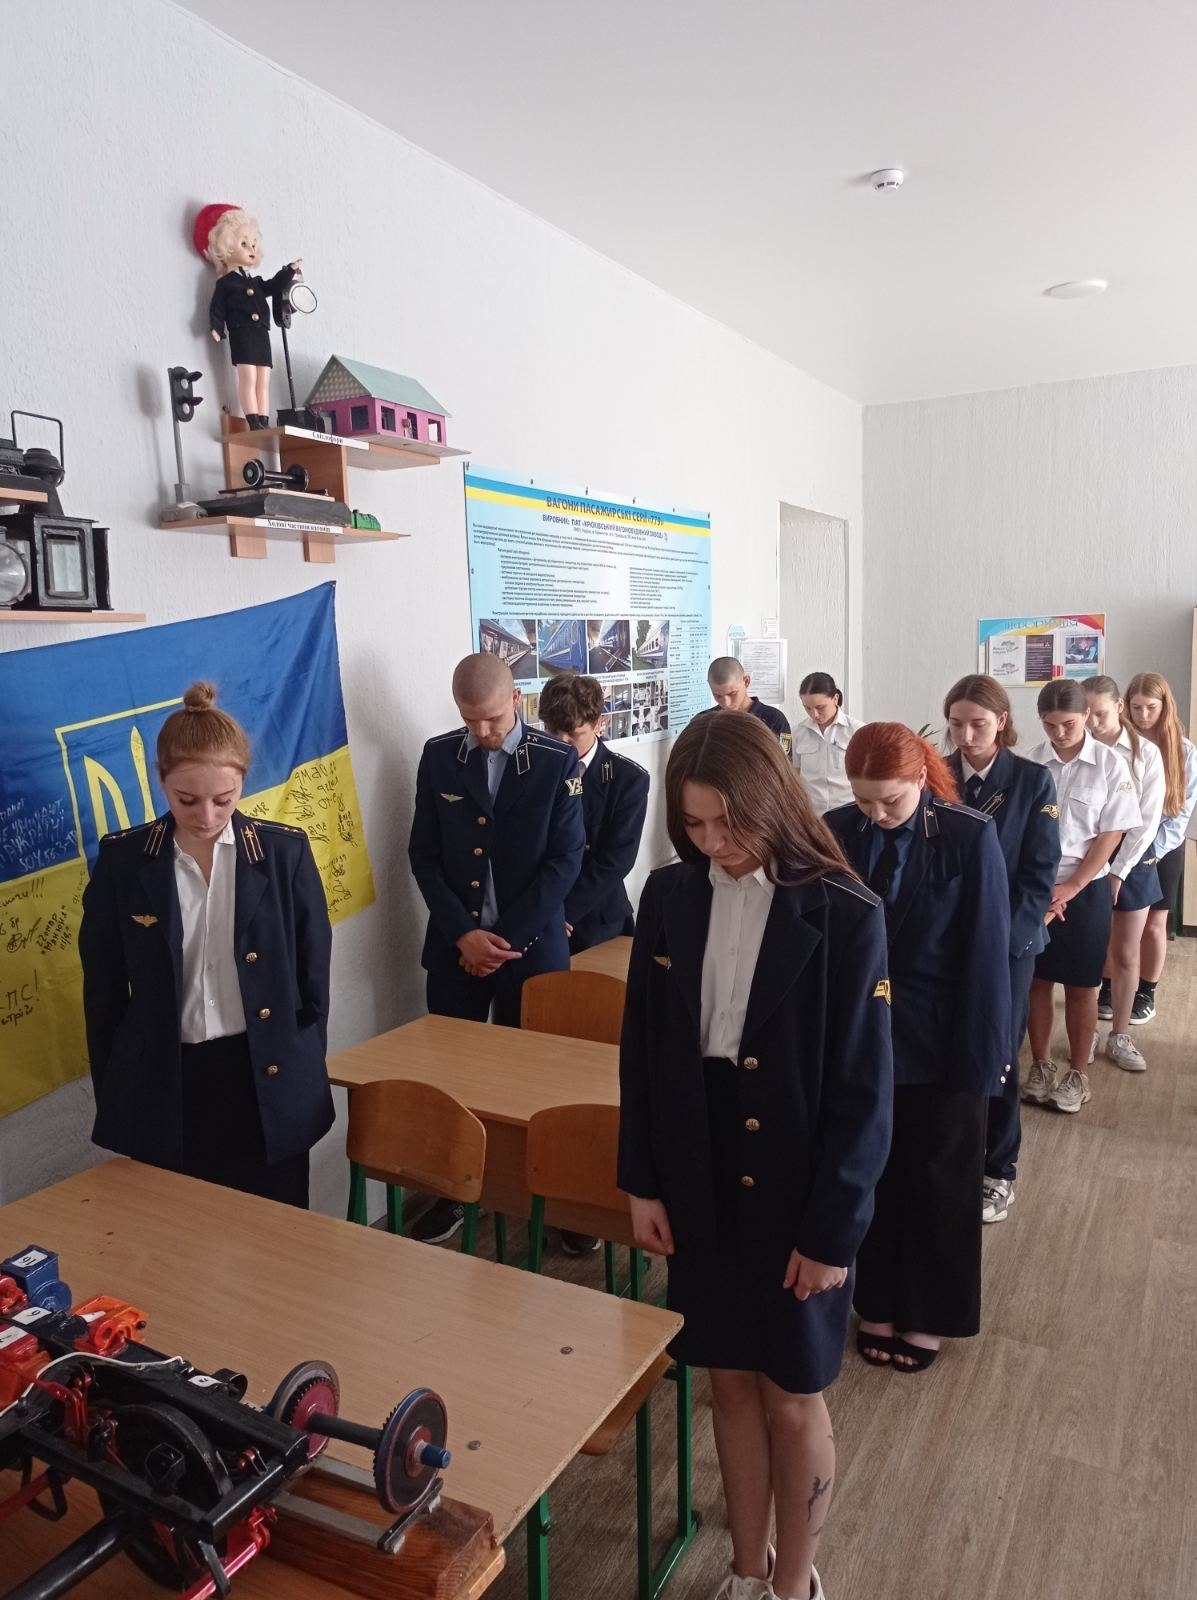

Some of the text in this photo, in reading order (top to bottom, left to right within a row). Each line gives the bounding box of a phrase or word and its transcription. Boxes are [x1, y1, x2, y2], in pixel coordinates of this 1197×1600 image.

[546, 496, 579, 512] ВАГОНИ
[580, 501, 631, 521] ПАСАЖИРСЬКІ
[571, 518, 581, 527] ПАТ
